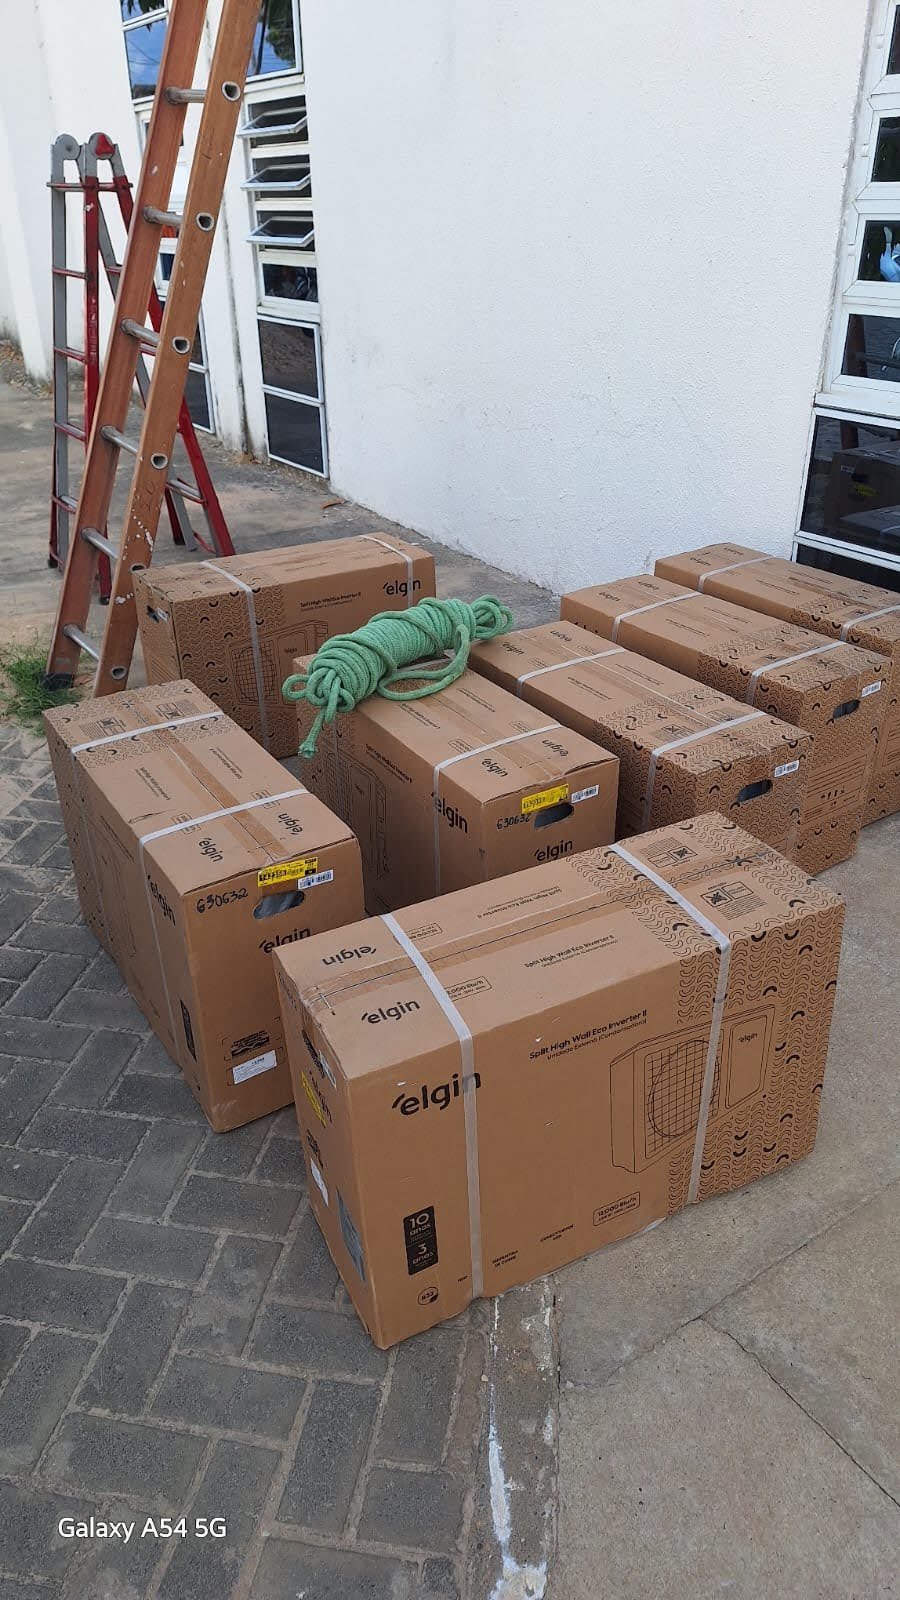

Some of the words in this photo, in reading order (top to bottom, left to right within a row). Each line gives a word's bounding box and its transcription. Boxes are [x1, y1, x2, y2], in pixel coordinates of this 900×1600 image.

[529, 1047, 549, 1060] Split
[550, 1040, 571, 1051] High
[571, 1030, 591, 1043] Wall
[592, 1025, 607, 1036] Eco
[608, 1012, 641, 1030] Inverter
[409, 1212, 429, 1229] 10
[409, 1224, 431, 1236] anos
[417, 1242, 427, 1255] 3
[412, 1252, 434, 1264] anos
